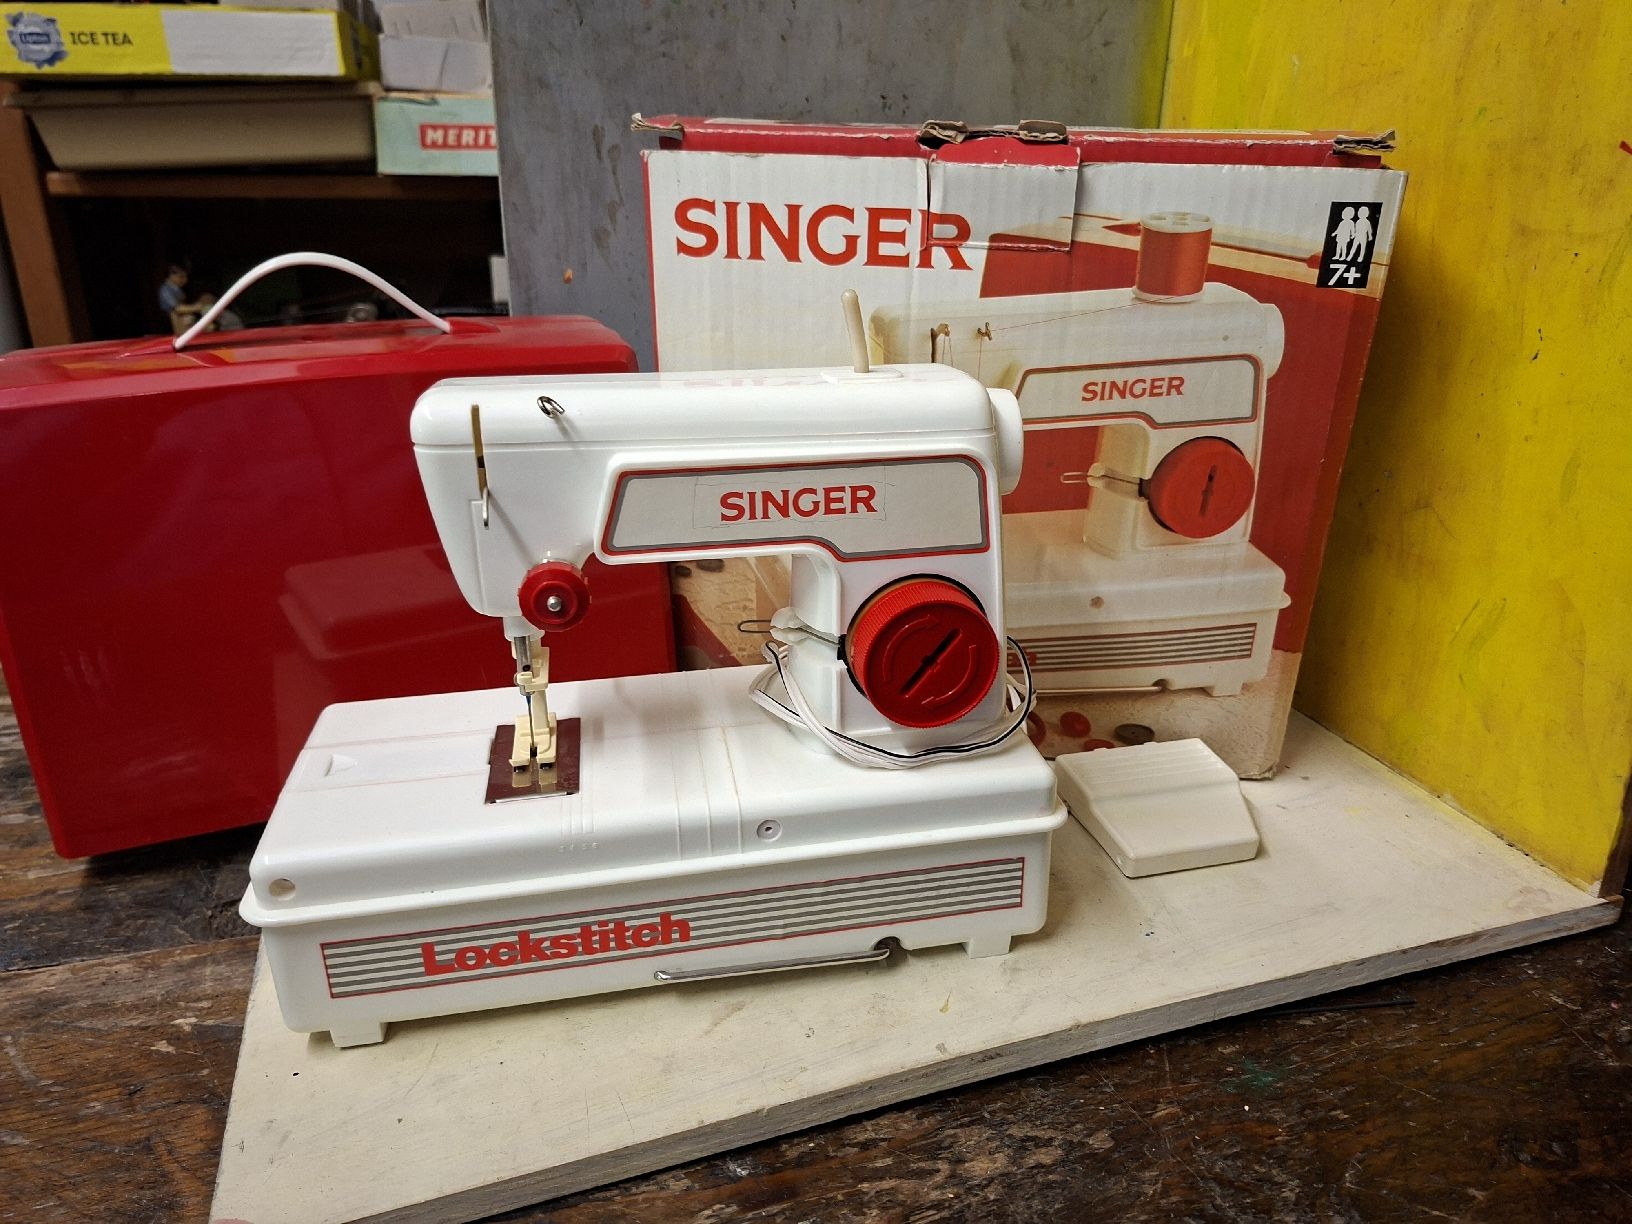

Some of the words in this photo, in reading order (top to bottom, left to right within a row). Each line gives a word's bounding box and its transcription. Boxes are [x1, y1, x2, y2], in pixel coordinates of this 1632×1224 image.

[69, 31, 98, 45] ICE
[101, 32, 133, 46] TEA
[674, 197, 973, 271] SINGER
[1328, 263, 1361, 286] 7+
[1081, 376, 1185, 402] SINGER
[719, 484, 878, 522] SINGER
[421, 911, 691, 977] Lockstitch
